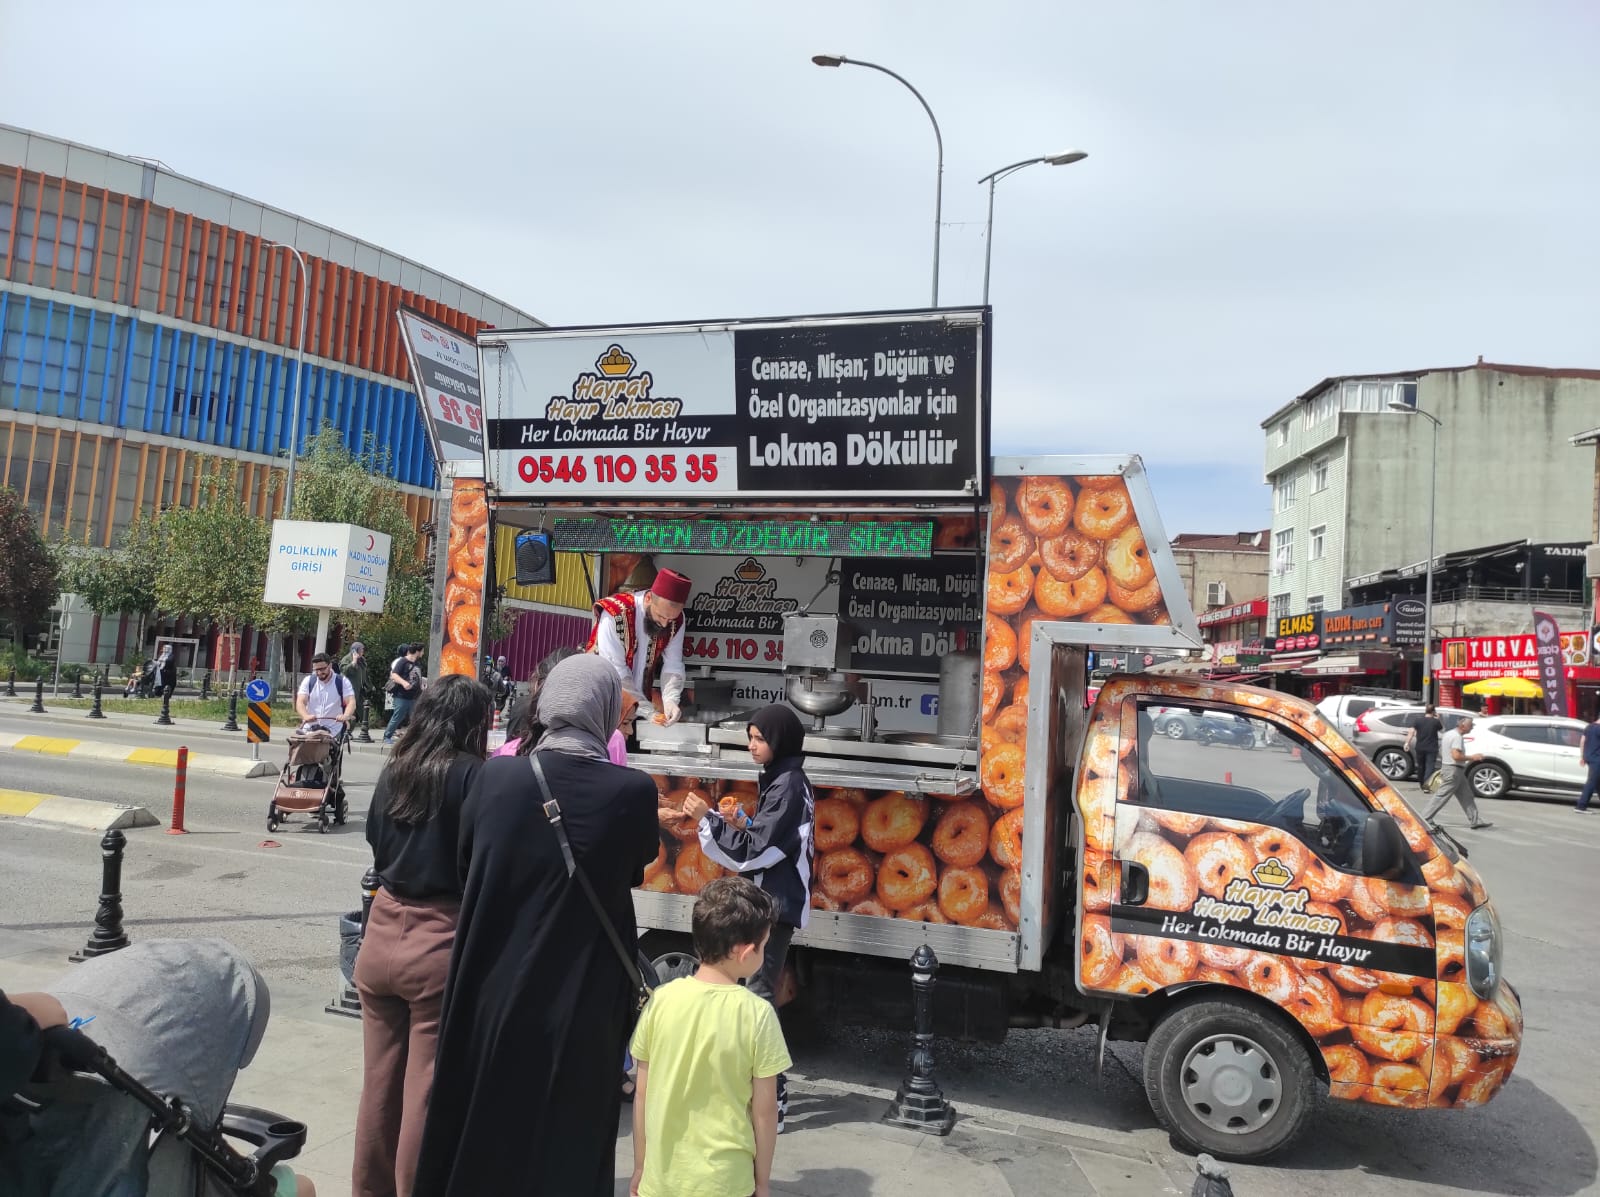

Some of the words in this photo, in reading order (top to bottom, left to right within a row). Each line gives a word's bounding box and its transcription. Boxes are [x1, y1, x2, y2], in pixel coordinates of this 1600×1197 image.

[752, 356, 812, 383] Cenaze,
[817, 352, 868, 384] Nişan,
[874, 349, 929, 383] Düğün
[934, 354, 955, 375] ve
[575, 374, 651, 402] Hayrat
[548, 398, 599, 424] Hayır
[603, 397, 680, 420] Lokması
[749, 388, 783, 419] Özel
[788, 389, 922, 424] Organizasyonlar
[927, 388, 957, 420] için
[521, 424, 549, 443] Her
[554, 424, 628, 443] Lokmada
[634, 423, 657, 441] Bir
[663, 421, 711, 444] Hayır
[749, 433, 838, 467] Lokma
[847, 430, 958, 466] Dökülür
[518, 455, 587, 483] 0546
[594, 454, 637, 483] 110
[645, 454, 677, 483] 35
[685, 454, 718, 482] 35
[611, 524, 692, 547] YAREN
[279, 545, 338, 557] POLİKLİNİK
[349, 550, 366, 561] KADIN
[1544, 547, 1586, 557] TADIM
[291, 560, 322, 574] GİRİŞİ
[716, 579, 774, 600] Hayrat
[852, 572, 898, 593] Cenaze,
[903, 572, 941, 595] Nişan,
[945, 573, 978, 597] Düğü
[693, 595, 734, 613] Hayır
[849, 595, 875, 618] Özel
[697, 615, 754, 629] Lokmada
[758, 616, 779, 630] Bir
[1279, 614, 1314, 636] ELMAS
[1324, 615, 1352, 633] TADIM
[683, 636, 720, 659] 546
[726, 638, 759, 660] 110
[1470, 638, 1536, 658] TURVA
[1226, 879, 1307, 911] Hayrat
[1193, 896, 1251, 923] Hayır
[1254, 905, 1340, 935] Lokması
[1161, 915, 1194, 935] Her
[1198, 920, 1281, 949] Lokmada
[1286, 933, 1315, 952] Bir
[1317, 938, 1372, 962] Hayır
